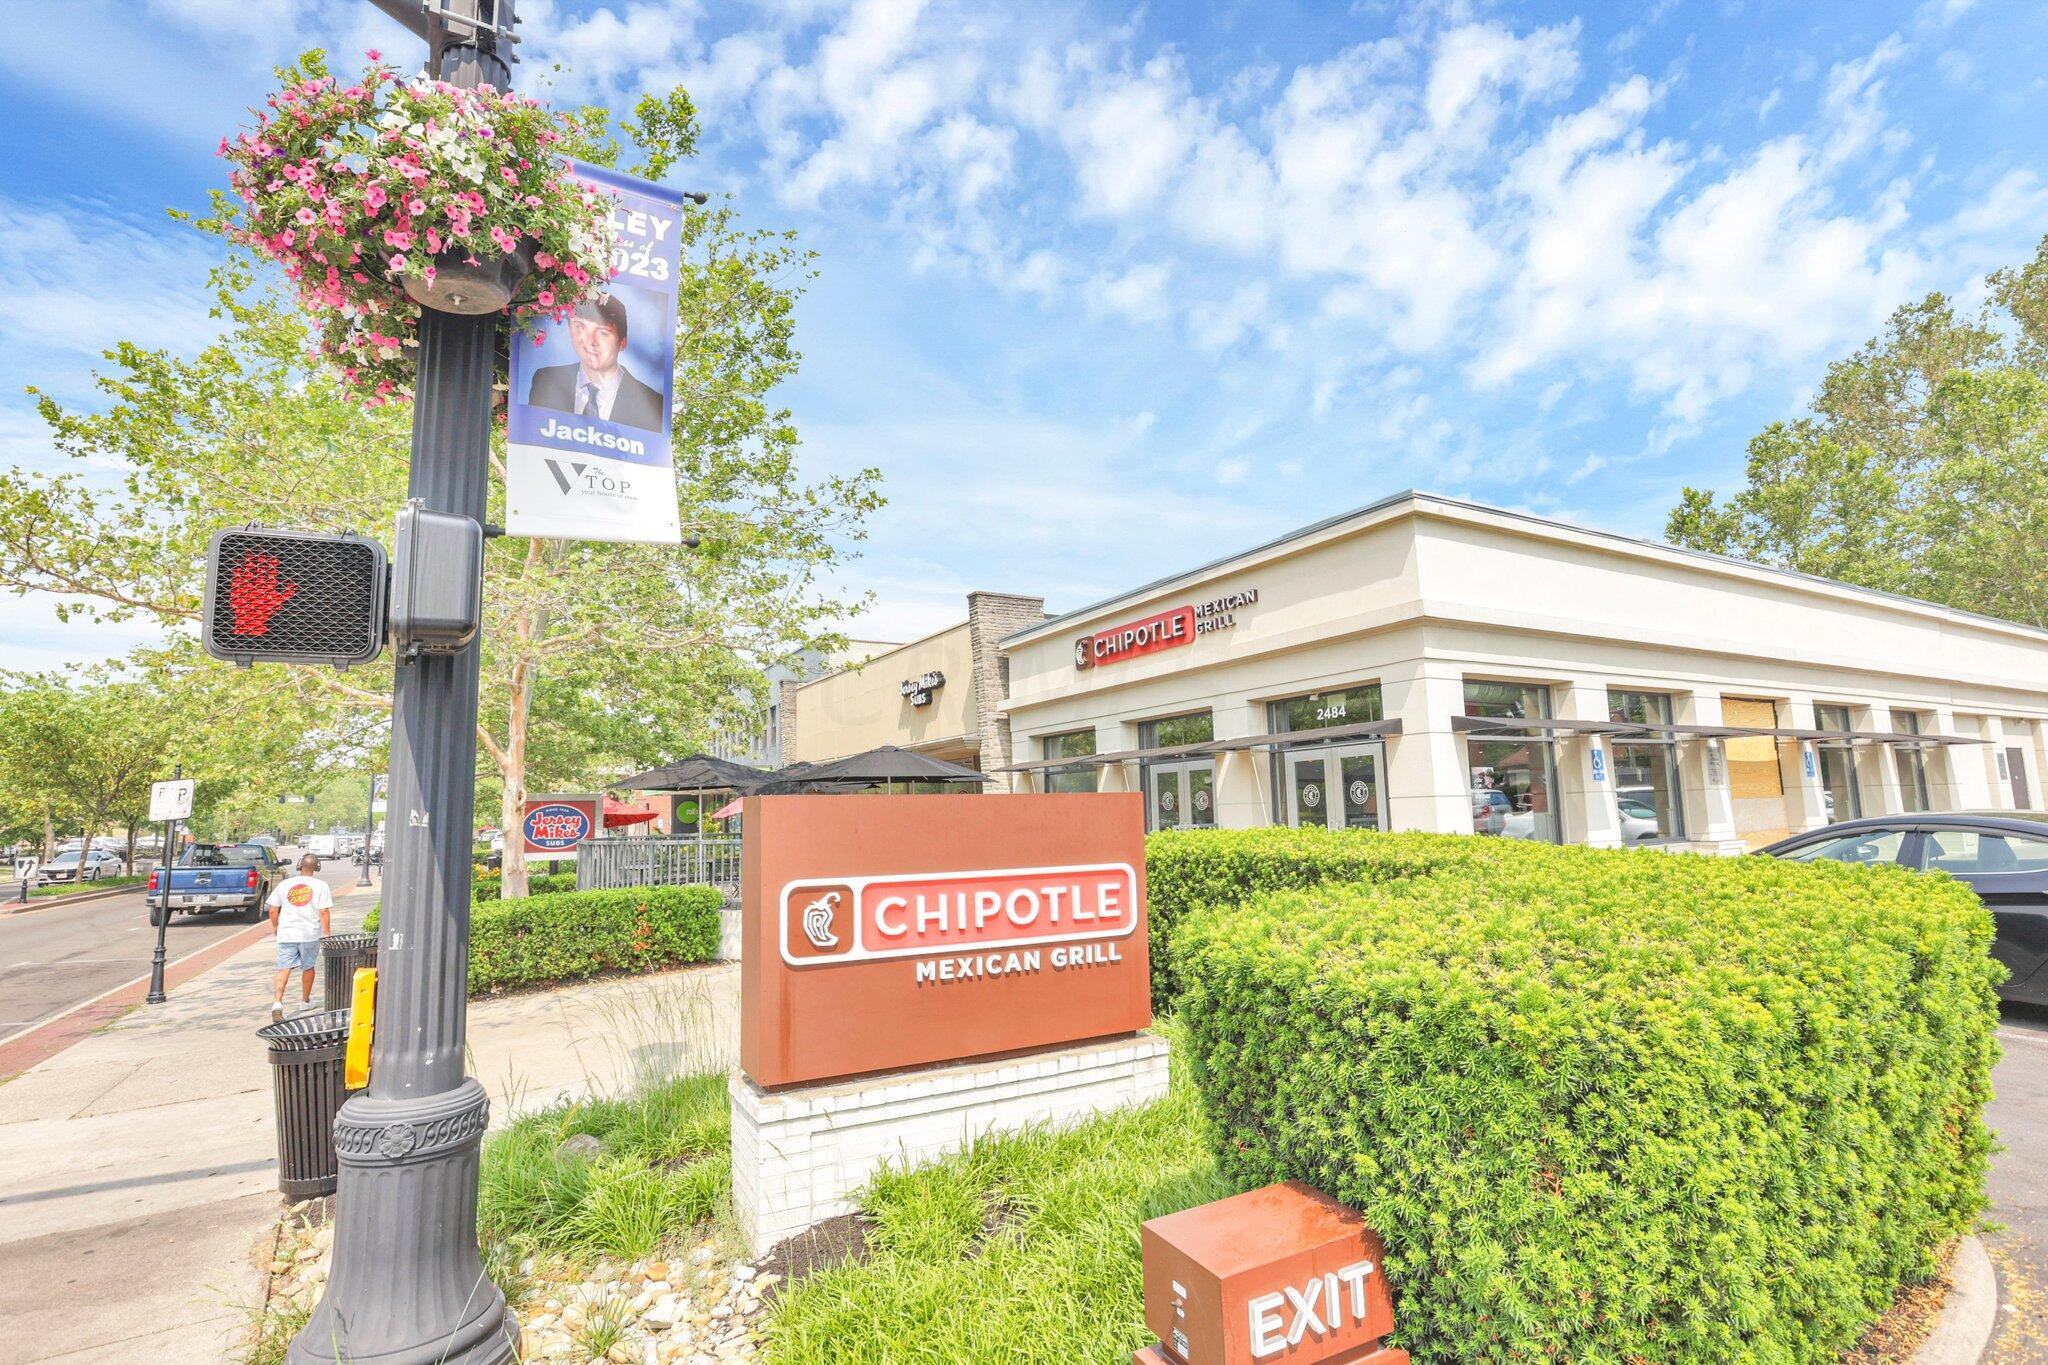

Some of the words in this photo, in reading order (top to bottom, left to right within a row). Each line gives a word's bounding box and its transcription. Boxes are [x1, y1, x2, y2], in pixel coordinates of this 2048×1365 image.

[607, 210, 672, 241] LEY
[611, 248, 669, 281] 023
[540, 418, 645, 456] Jackson
[585, 475, 630, 493] TOP
[1194, 589, 1258, 618] MEXICAN
[1094, 614, 1184, 657] CHIPOTLE
[1195, 614, 1236, 635] GRILL
[1316, 704, 1347, 720] 2484
[530, 811, 582, 828] Jersey
[874, 881, 1122, 936] CHIPOTLE
[915, 950, 1040, 983] MEXICAN
[1050, 942, 1123, 969] GRILL
[1248, 1260, 1374, 1359] EXIT
